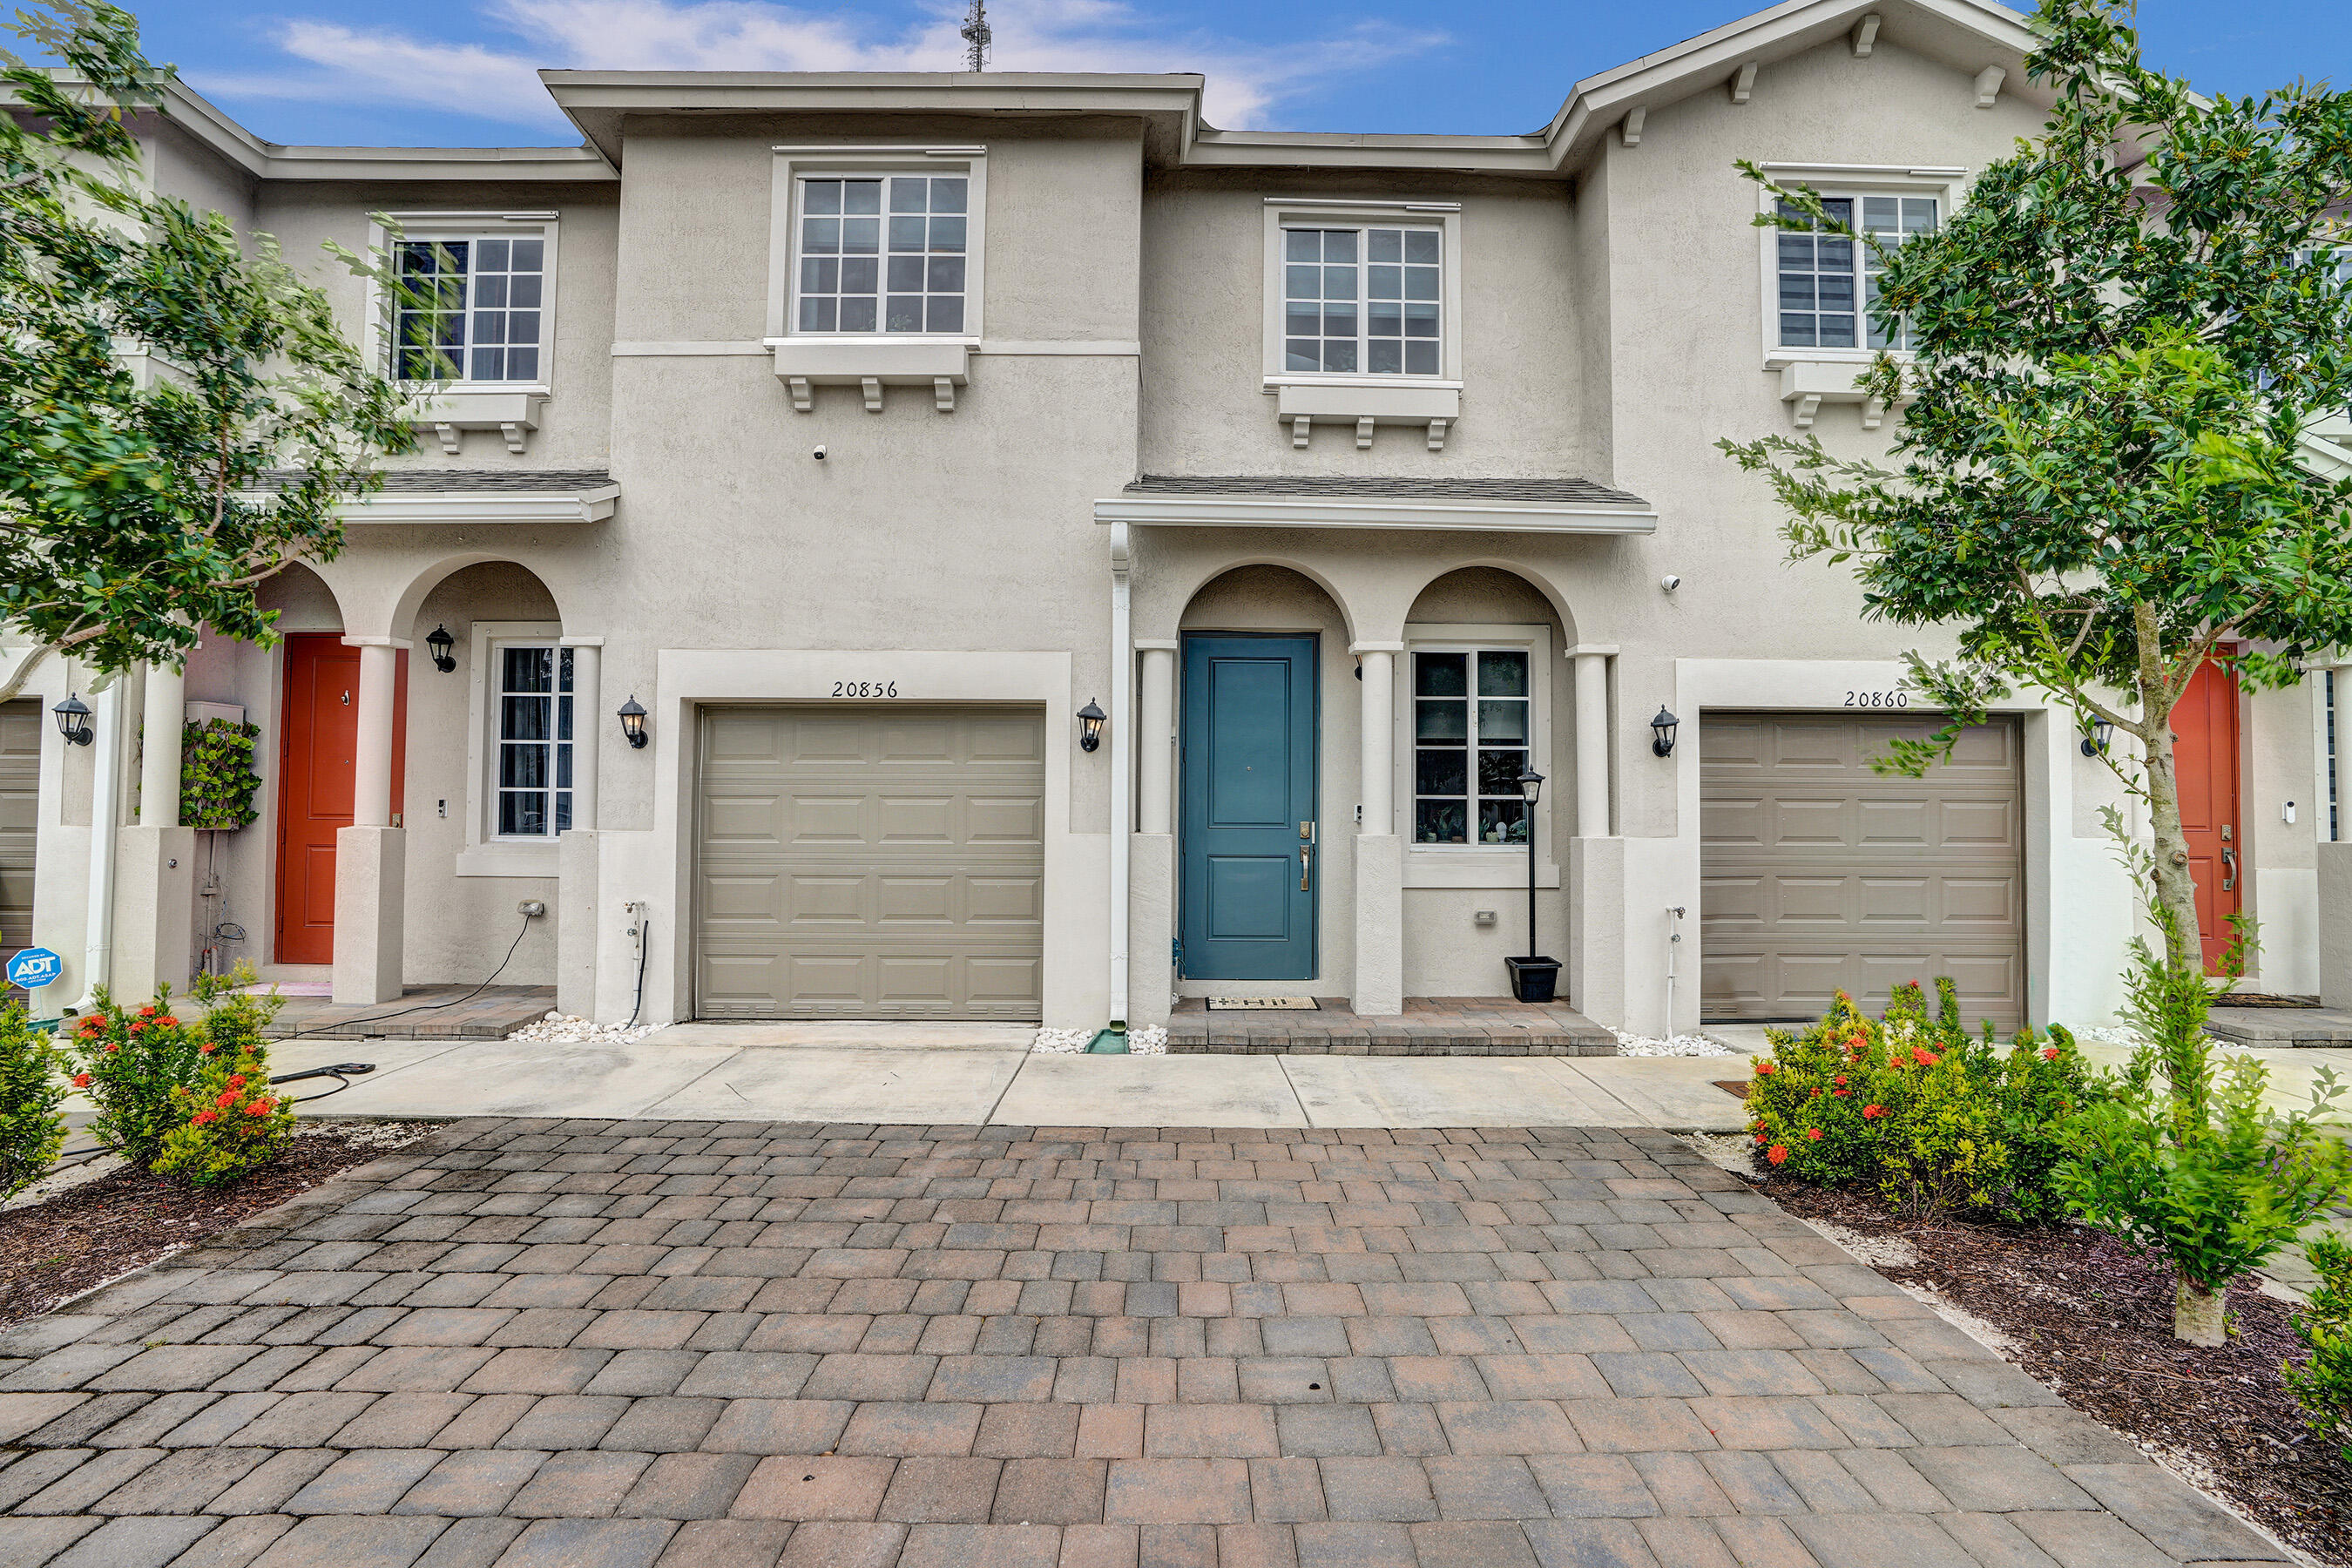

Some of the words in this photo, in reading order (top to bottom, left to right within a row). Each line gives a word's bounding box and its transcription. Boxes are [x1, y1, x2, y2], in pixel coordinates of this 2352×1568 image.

[832, 681, 897, 698] 20856
[1844, 690, 1907, 707] 20860
[14, 956, 56, 977] ADT
